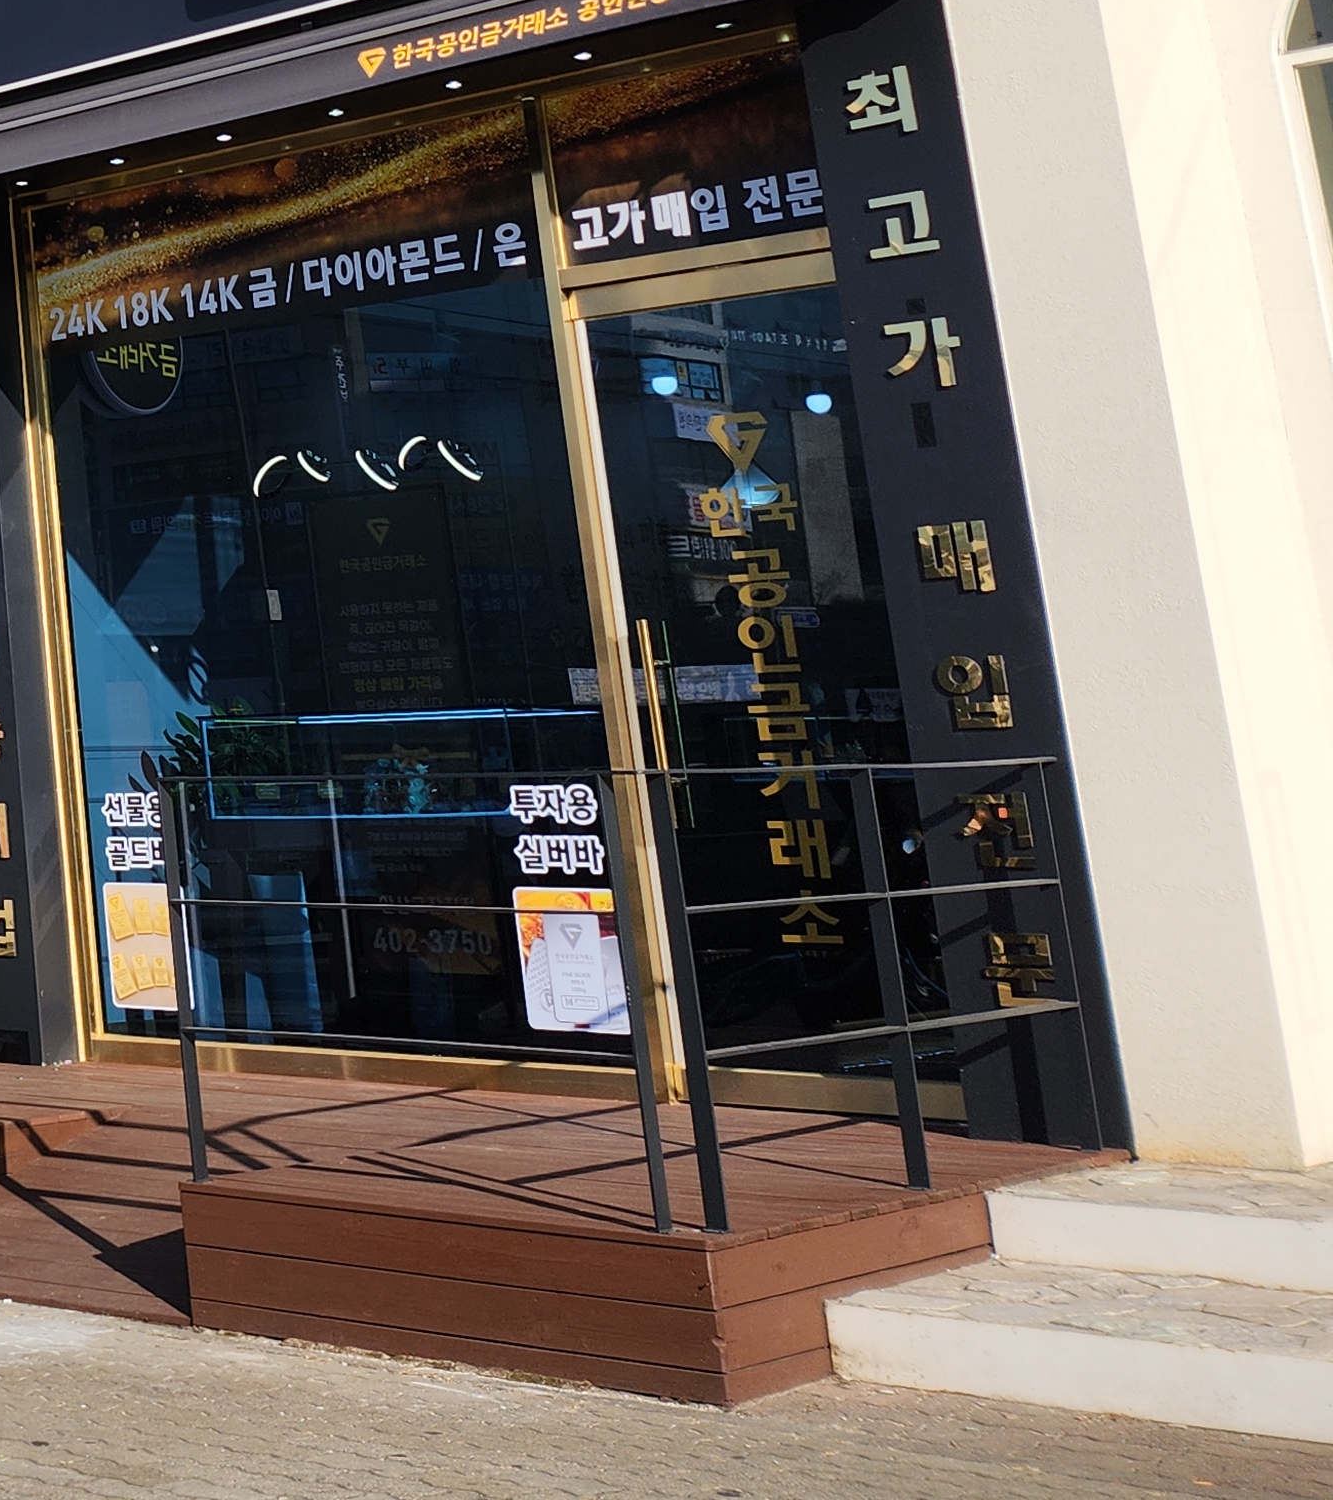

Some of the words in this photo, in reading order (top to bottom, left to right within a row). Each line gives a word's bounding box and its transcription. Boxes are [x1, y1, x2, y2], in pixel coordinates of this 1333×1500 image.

[391, 6, 569, 70] 한국공인금거래소
[742, 168, 825, 227] 전문
[49, 300, 105, 342] 24K
[116, 286, 172, 331] 18K
[180, 271, 244, 320] 14K
[247, 268, 278, 312] 금
[303, 231, 464, 301] 다이아몬드
[492, 223, 528, 269] 은
[697, 482, 845, 946] 한국공인금거래소
[510, 784, 598, 825] 투자용
[514, 834, 605, 875] 실버바
